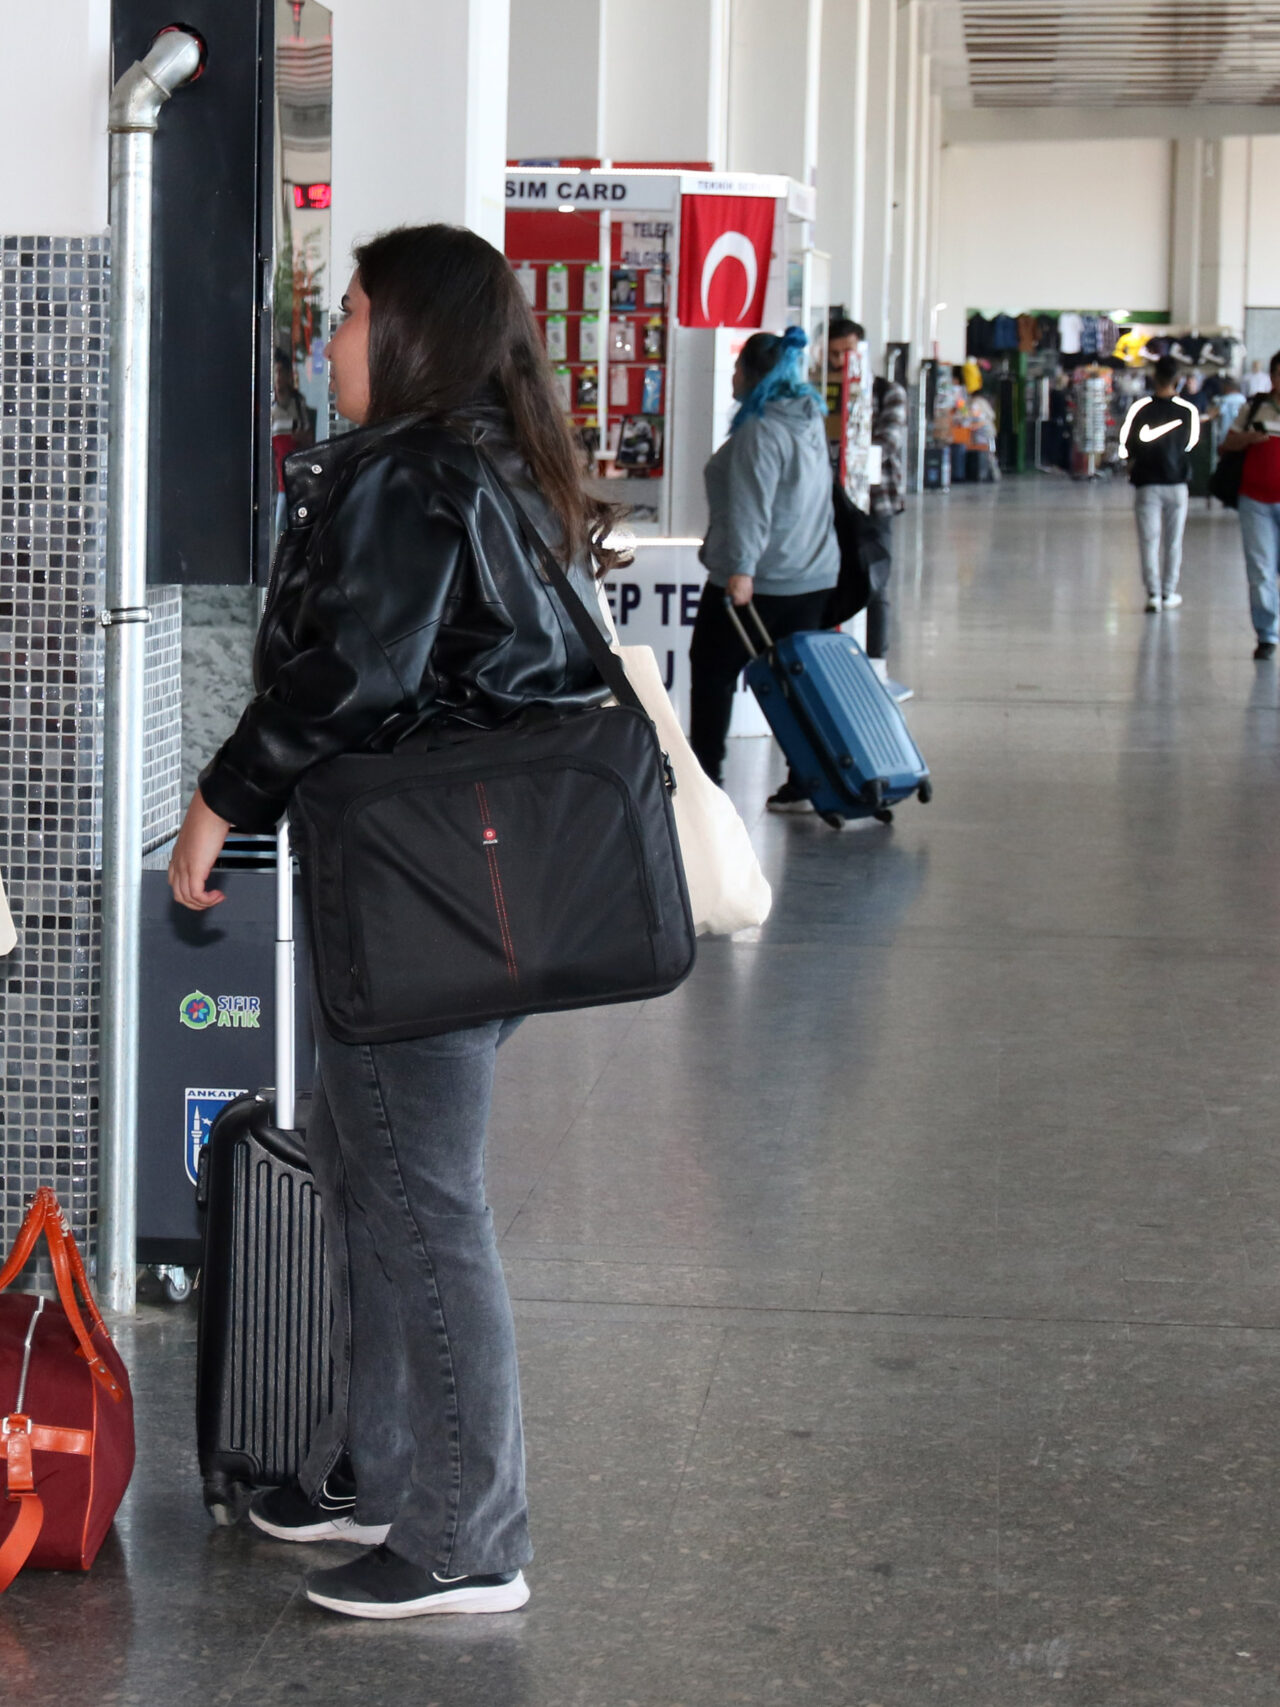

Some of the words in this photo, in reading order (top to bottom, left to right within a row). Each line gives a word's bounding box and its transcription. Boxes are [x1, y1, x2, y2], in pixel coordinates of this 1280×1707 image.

[505, 181, 547, 199] SIM
[557, 182, 627, 201] CARD
[218, 996, 260, 1011] SIFIR
[217, 1011, 261, 1028] ATIK
